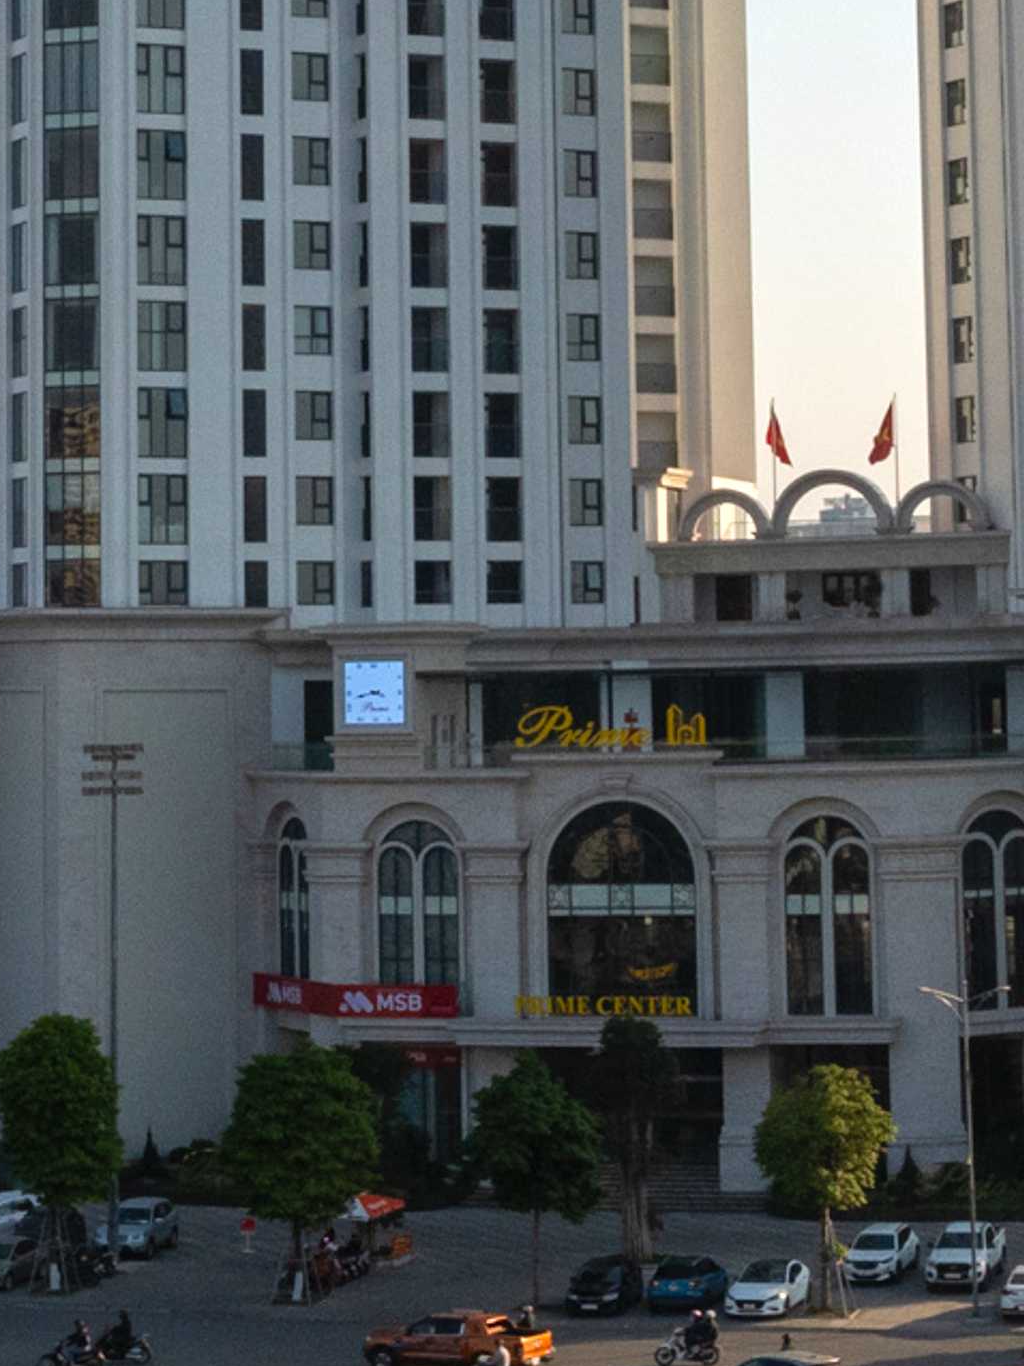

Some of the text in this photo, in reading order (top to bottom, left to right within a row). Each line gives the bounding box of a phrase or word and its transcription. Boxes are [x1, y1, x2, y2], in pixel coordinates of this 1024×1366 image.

[515, 705, 651, 748] Prime
[377, 993, 423, 1012] MSB
[515, 995, 693, 1016] PRIME CENTER
